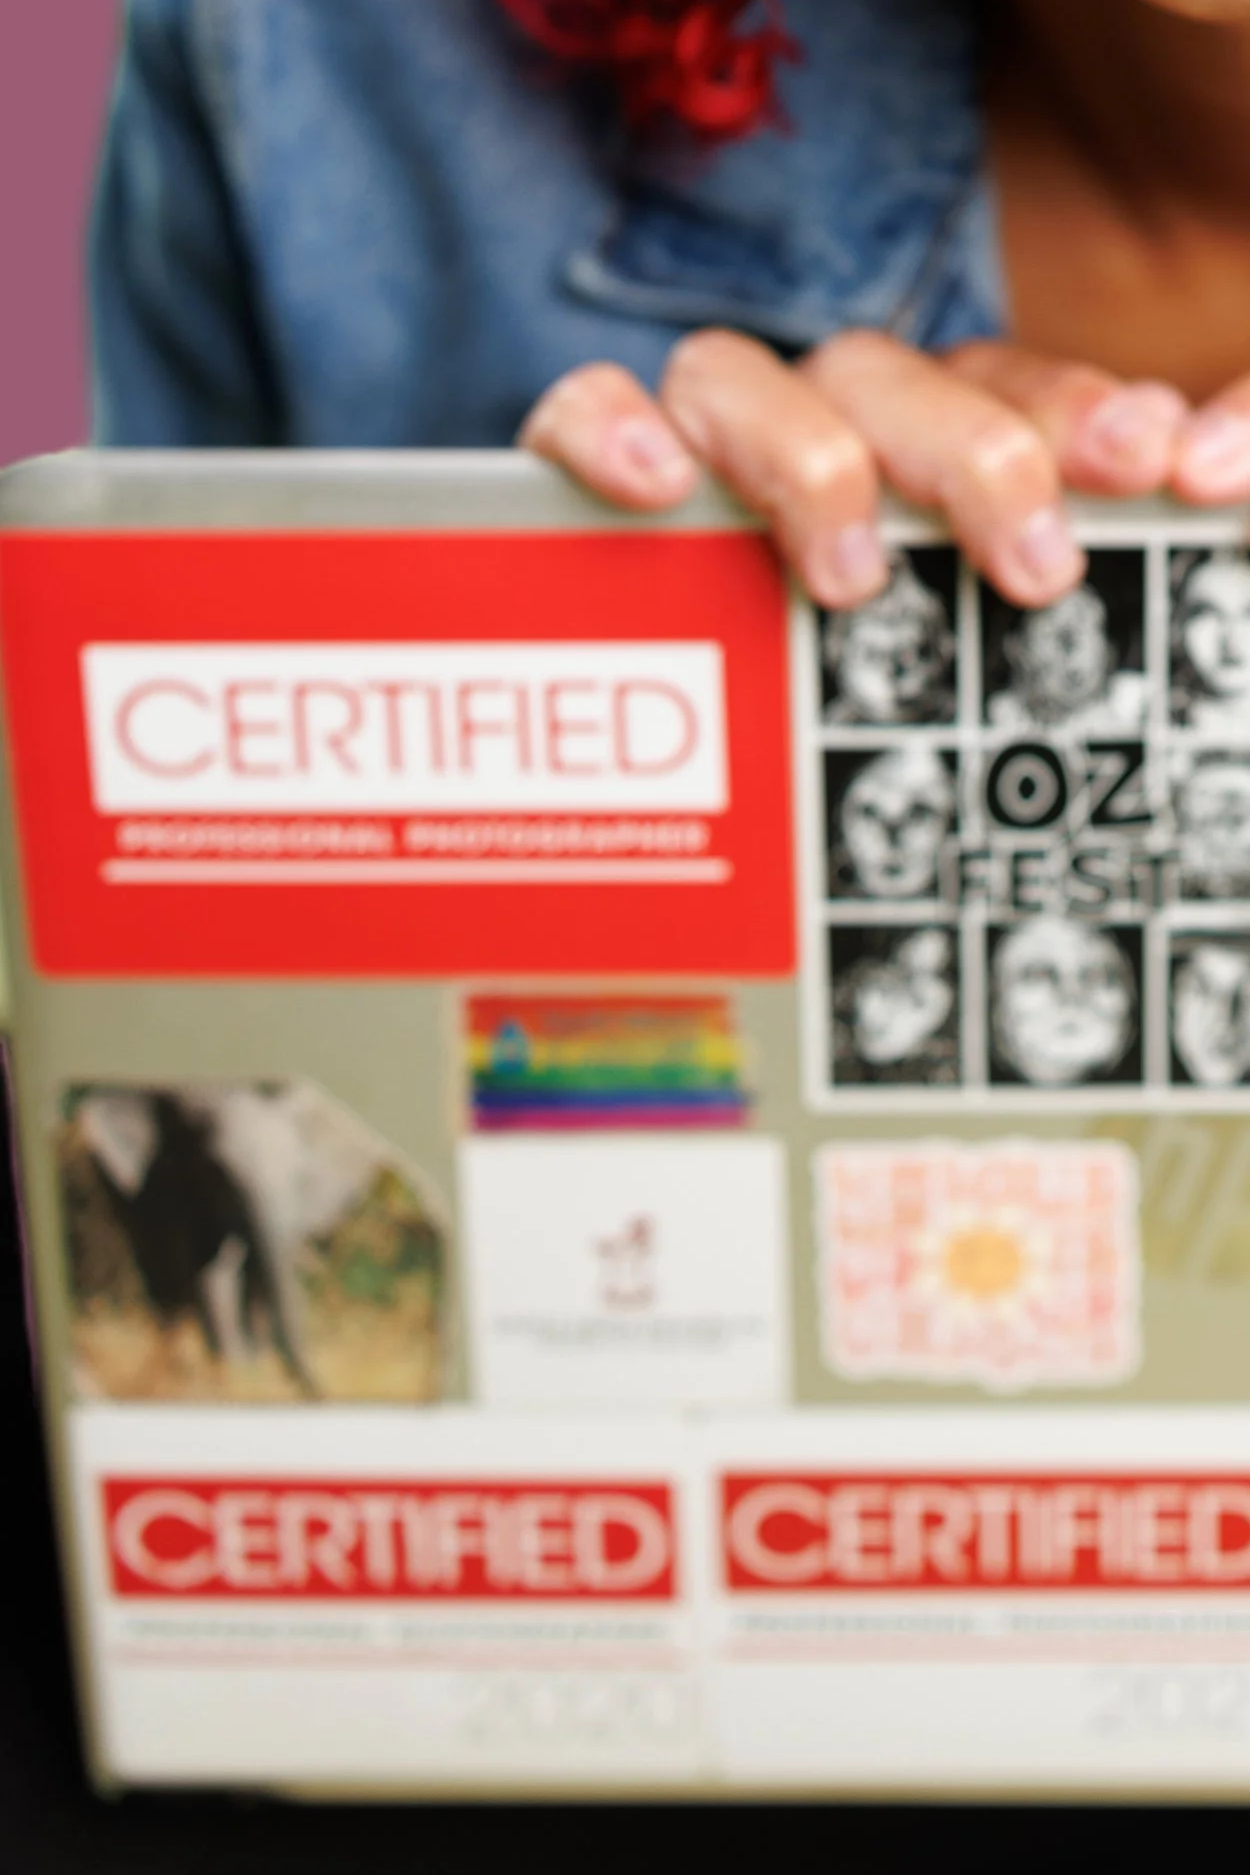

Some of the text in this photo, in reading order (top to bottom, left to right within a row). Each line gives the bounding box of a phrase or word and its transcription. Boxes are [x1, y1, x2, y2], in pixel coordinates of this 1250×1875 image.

[113, 677, 702, 781] CERTIFIED
[984, 739, 1158, 829] OZ
[944, 847, 1184, 916] FEST
[112, 1486, 673, 1592] CERTIFIED
